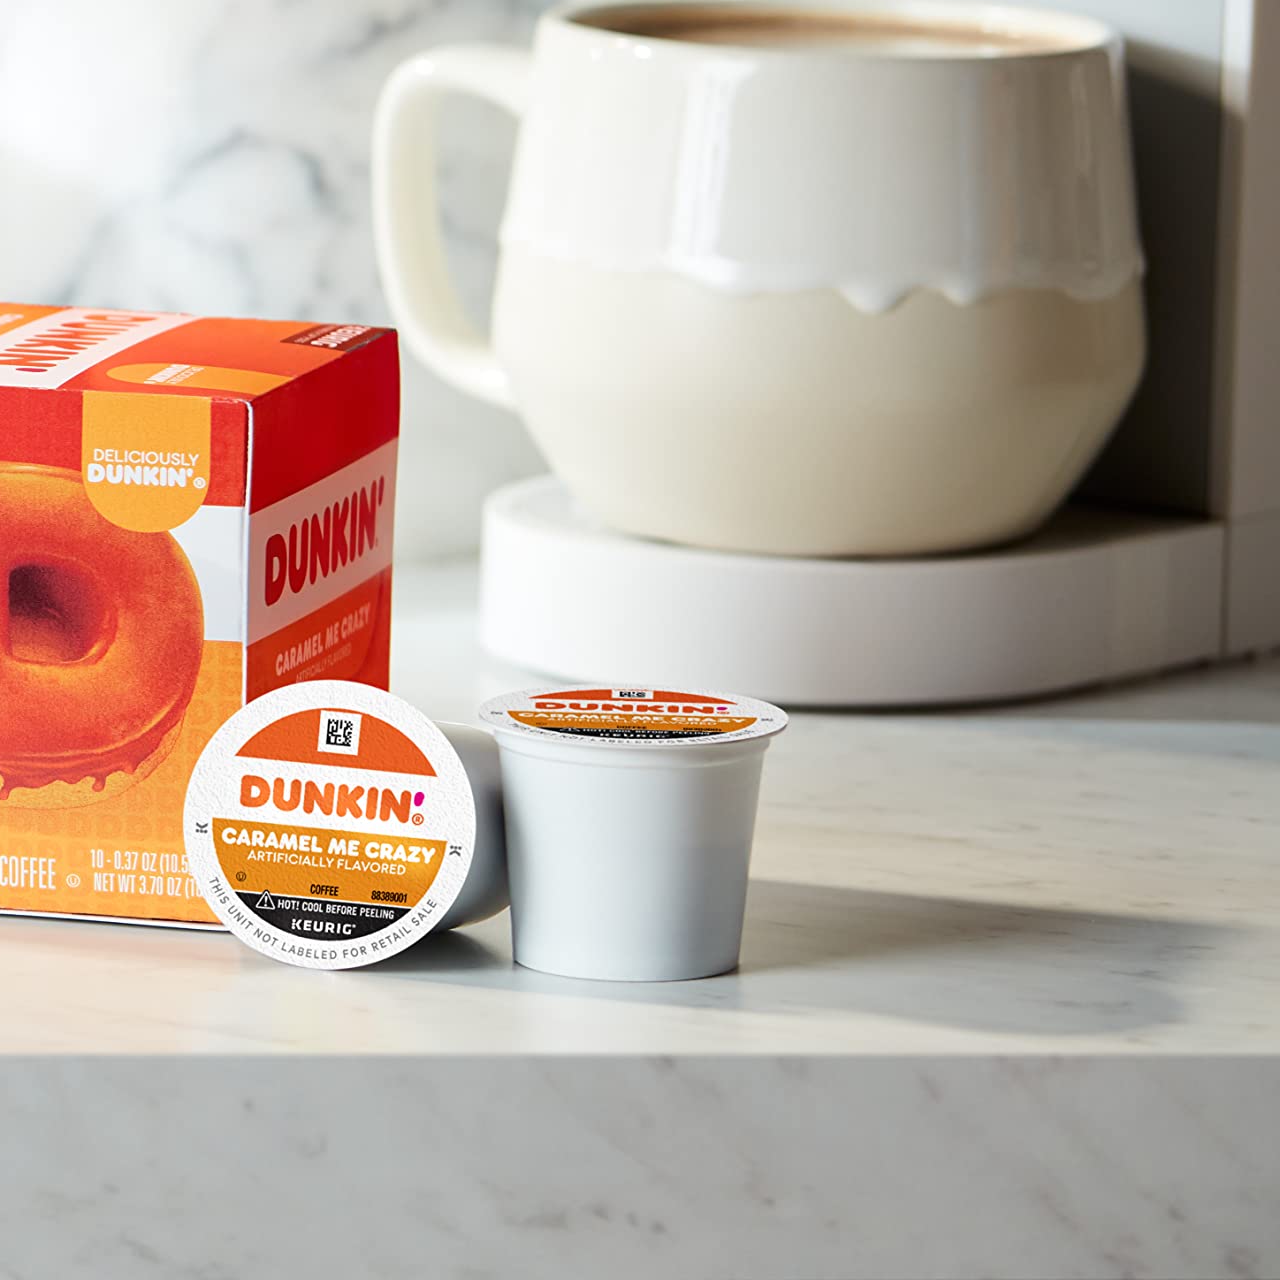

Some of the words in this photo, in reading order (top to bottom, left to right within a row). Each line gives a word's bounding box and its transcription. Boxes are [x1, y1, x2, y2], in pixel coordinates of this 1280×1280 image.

[93, 448, 200, 466] DELICIOUSLY
[87, 463, 193, 488] DUNKIN'
[264, 475, 385, 607] DUNKIN'
[275, 631, 323, 677] CARAMEL
[325, 621, 340, 645] ME
[341, 601, 371, 639] CRAZY
[535, 701, 728, 714] DUNKIN'
[239, 774, 425, 824] DUNKIN'
[221, 827, 323, 853] CARAMEL
[327, 839, 361, 857] ME
[365, 841, 436, 864] CRAZY
[0, 855, 56, 890] COFFEE
[90, 849, 104, 868] 10
[114, 850, 138, 871] 0.37
[141, 852, 157, 872] OZ
[247, 849, 334, 868] ARTIFICIALLY
[337, 859, 406, 876] FLAVORED
[93, 872, 115, 892] NET
[117, 874, 136, 893] WT
[139, 875, 163, 895] 3.70
[167, 877, 183, 896] OZ
[310, 884, 339, 896] COFFEE
[371, 890, 408, 903] 88389001
[208, 876, 230, 905] THIS
[227, 905, 254, 933] UNIT
[253, 928, 279, 948] NOT
[280, 943, 338, 960] LABELED
[343, 946, 367, 959] FOR
[372, 926, 412, 952] RETAIL
[411, 899, 437, 927] SALE
[277, 899, 300, 911] HOT!
[301, 902, 324, 913] COOL
[326, 904, 357, 916] BEFORE
[359, 907, 395, 920] PEELING
[291, 918, 352, 935] KEURIG
